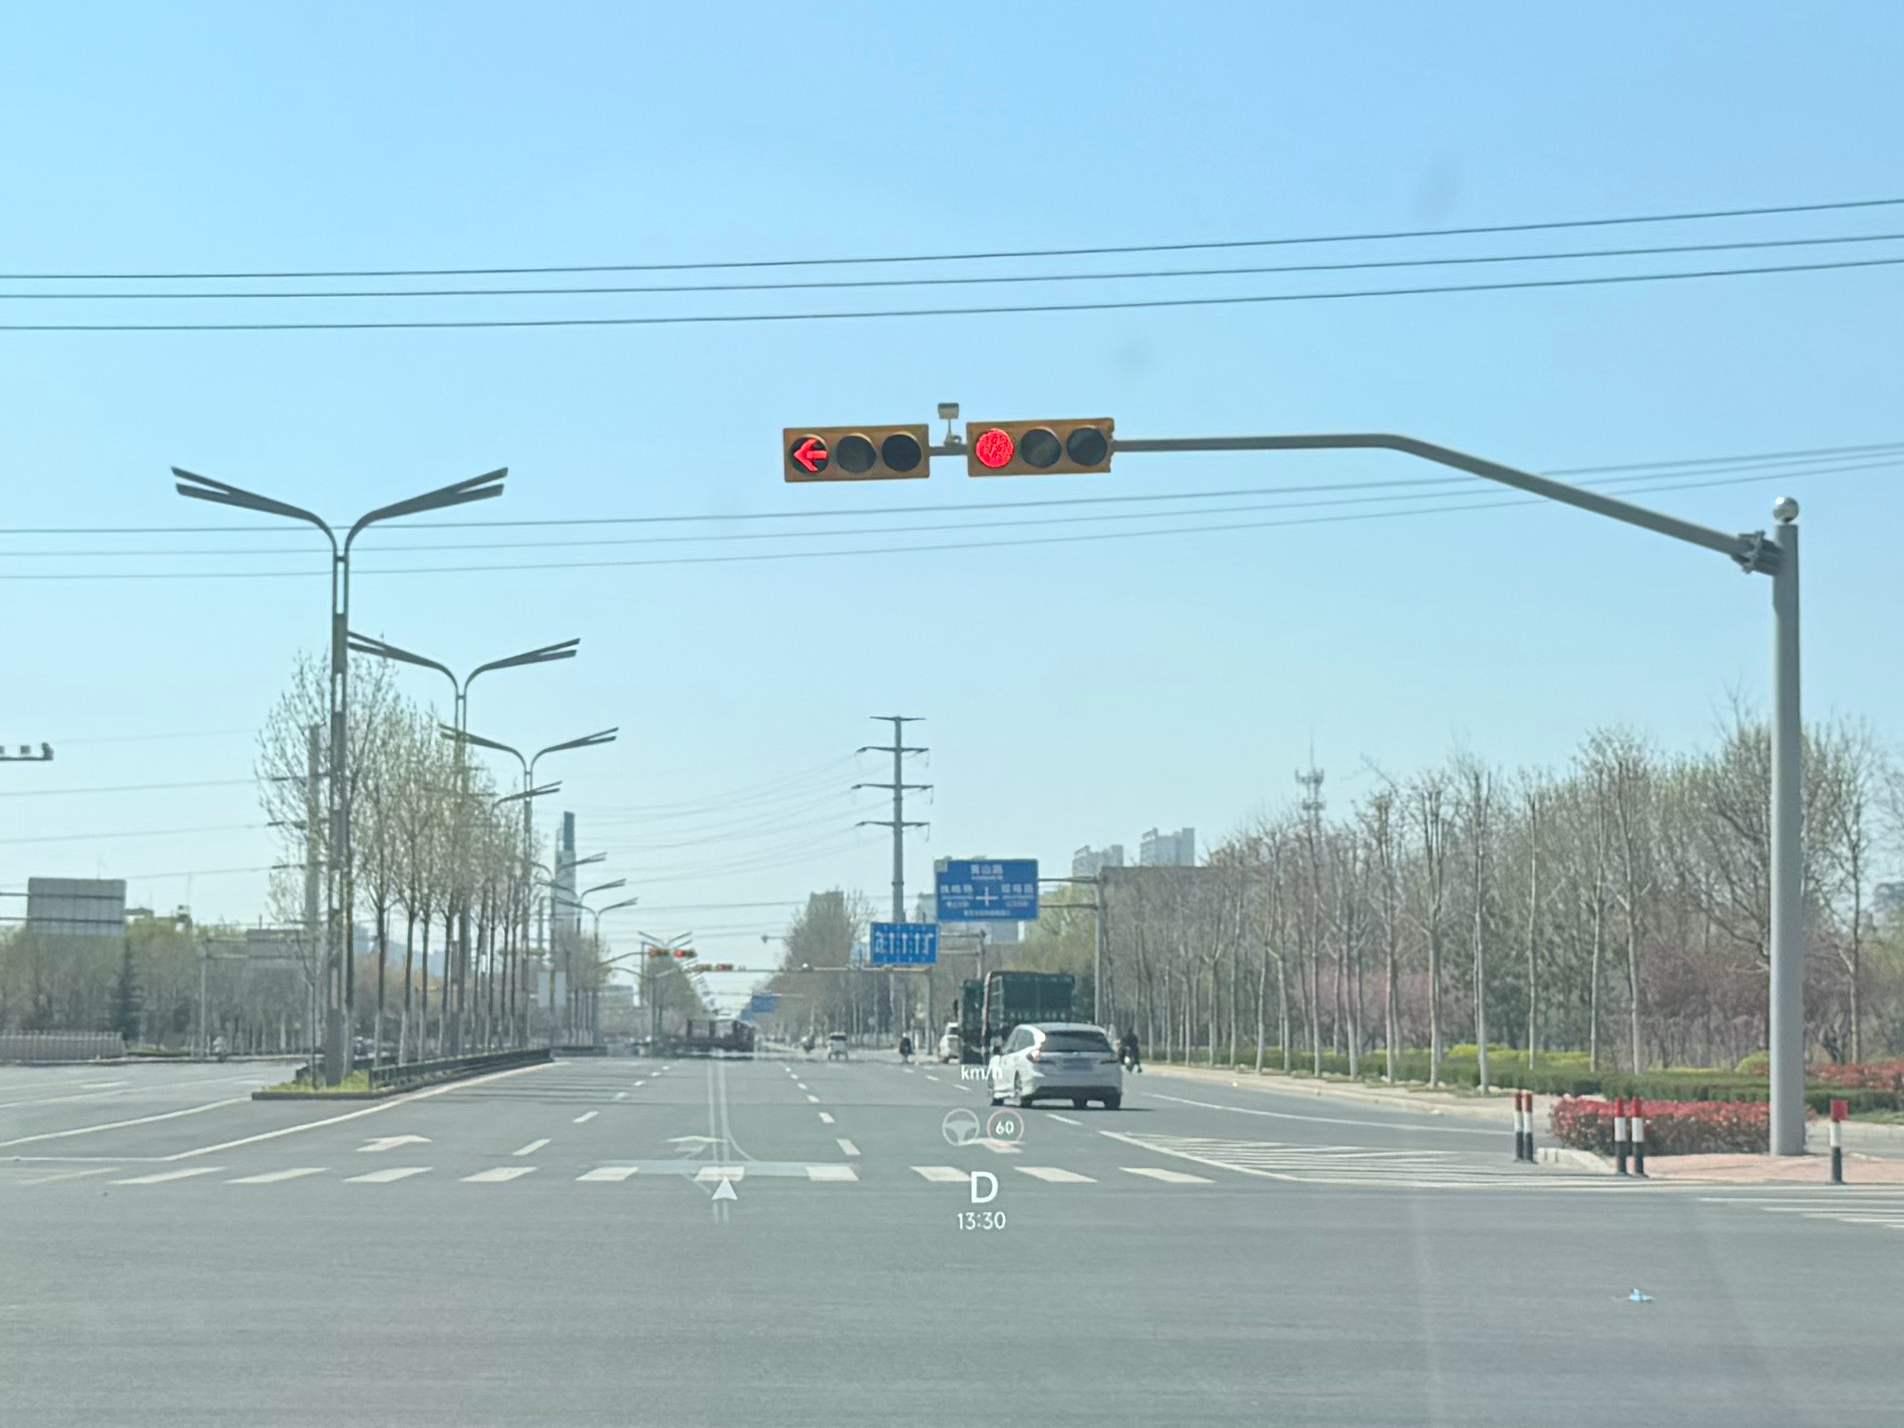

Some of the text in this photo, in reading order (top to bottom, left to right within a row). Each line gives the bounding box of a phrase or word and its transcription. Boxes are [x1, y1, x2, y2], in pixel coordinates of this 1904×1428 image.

[961, 1064, 1003, 1080] km/h
[996, 1120, 1014, 1135] 60
[971, 1171, 999, 1203] D
[957, 1211, 1006, 1230] 13:30
